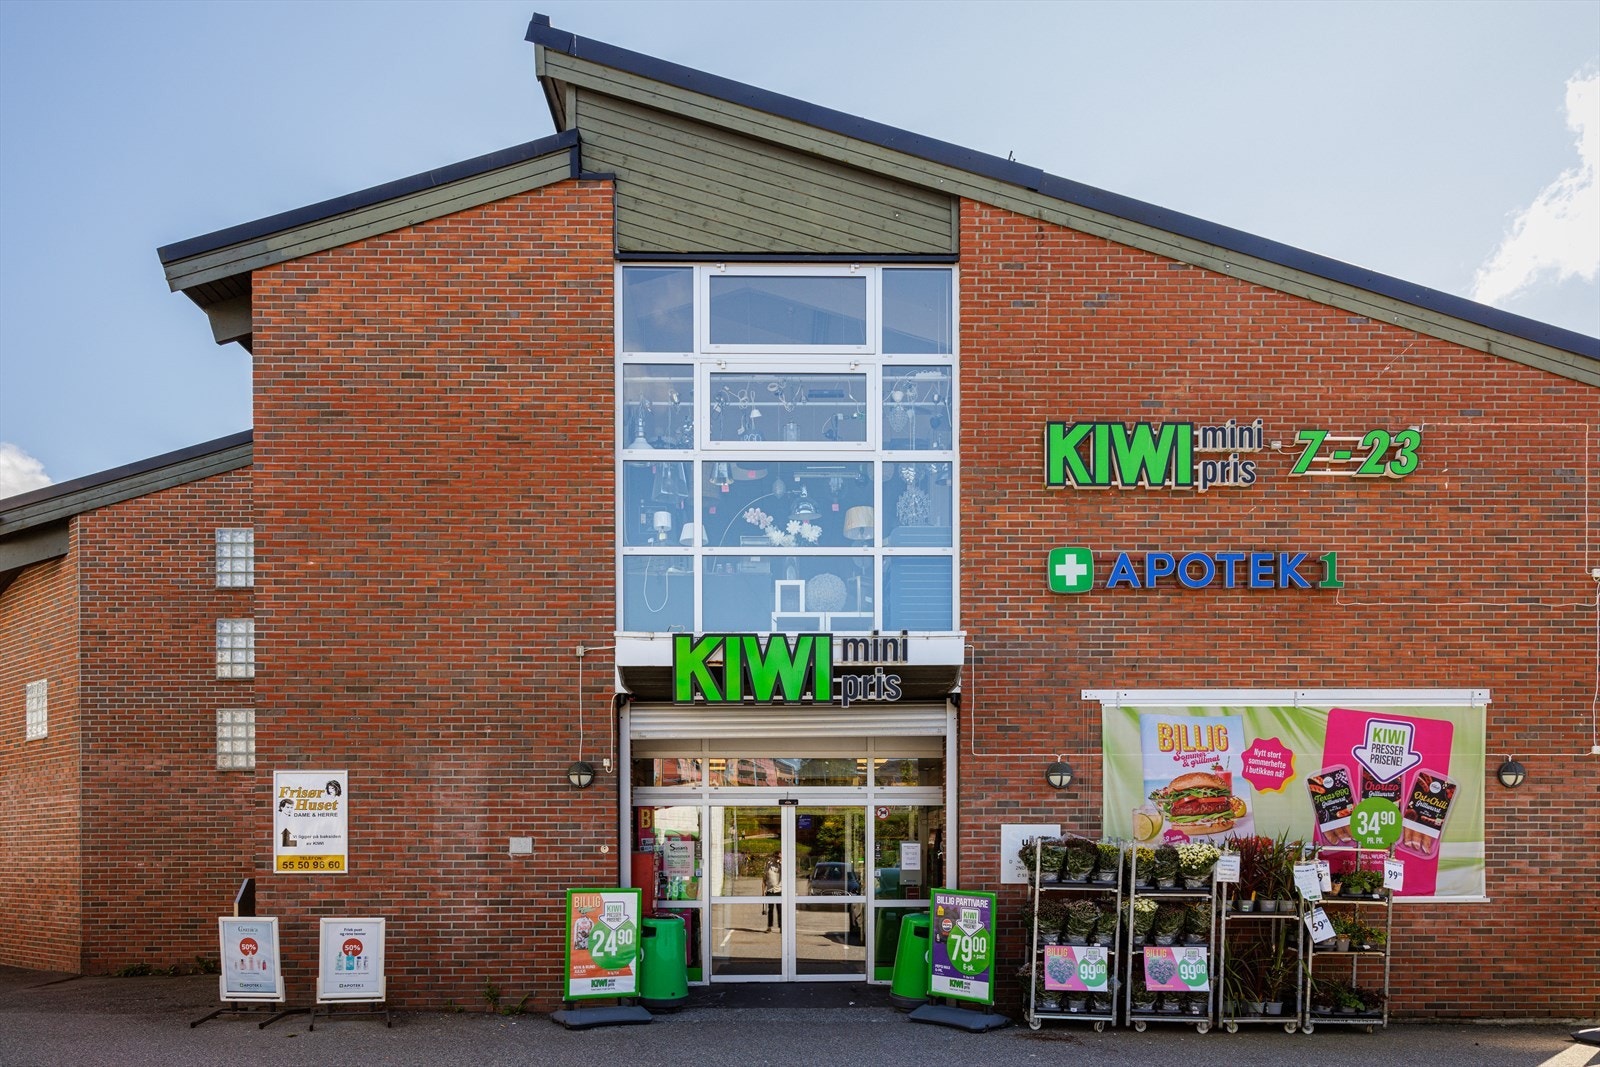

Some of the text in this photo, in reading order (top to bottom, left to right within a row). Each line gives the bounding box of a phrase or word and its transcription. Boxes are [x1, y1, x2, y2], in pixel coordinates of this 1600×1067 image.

[1045, 419, 1263, 488] KIWI mini
[1198, 454, 1257, 493] pris
[1105, 551, 1344, 589] APOTEK 1
[672, 630, 908, 705] KIWI mini
[841, 668, 902, 708] pris
[1157, 722, 1229, 752] BILLIG
[1372, 727, 1406, 746] KIWI
[1253, 748, 1281, 759] Nytt stort
[1371, 743, 1404, 756] PRESSER
[1248, 758, 1287, 769] sommerhefte
[1370, 754, 1403, 766] PRISENE!
[1249, 766, 1274, 776] butikken
[278, 786, 325, 798] Frisør
[1365, 781, 1399, 791] Chorizo
[294, 799, 338, 811] Huset
[282, 861, 294, 869] 55
[297, 861, 310, 869] 50
[328, 861, 340, 869] 60
[574, 895, 601, 908] BILLIG
[936, 896, 989, 909] BILLIG PARTIVARE
[606, 904, 622, 912] KIWI
[963, 911, 977, 919] KIWI
[1046, 948, 1068, 957] BILLIG
[1145, 949, 1167, 958] BILLIG
